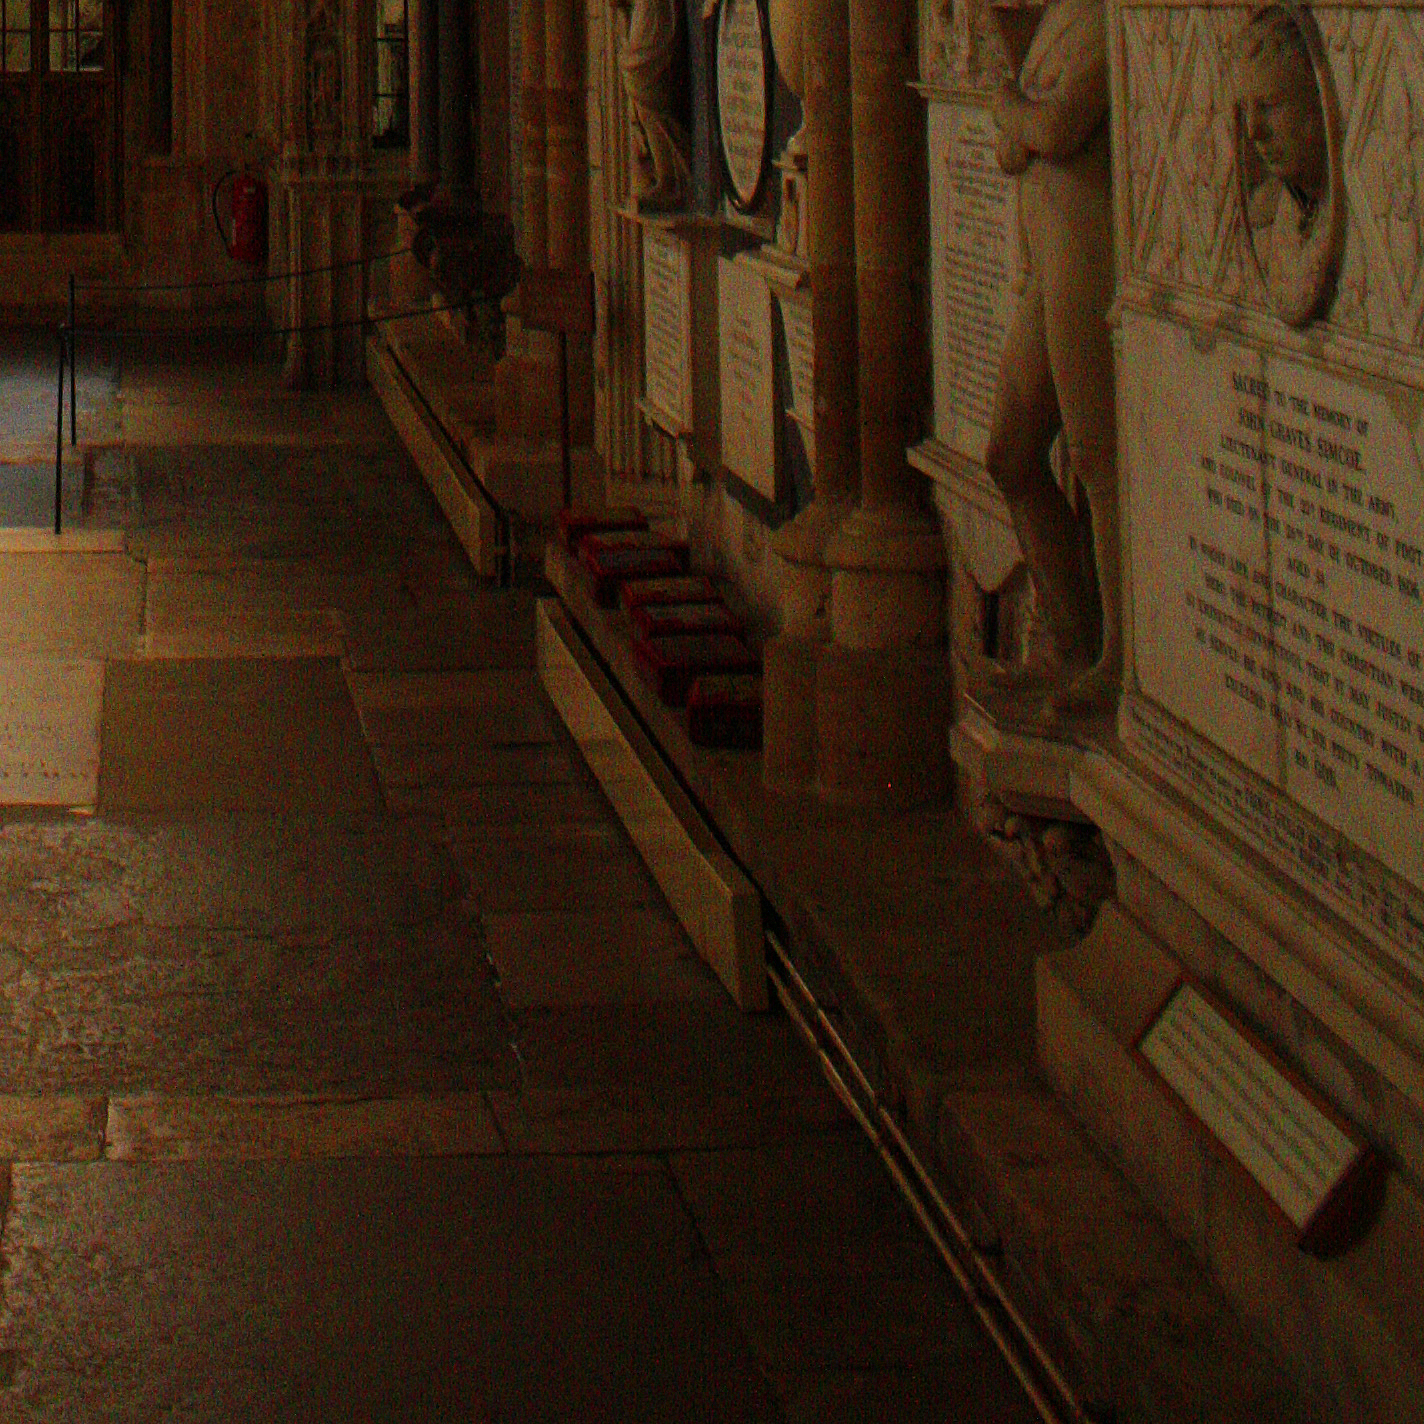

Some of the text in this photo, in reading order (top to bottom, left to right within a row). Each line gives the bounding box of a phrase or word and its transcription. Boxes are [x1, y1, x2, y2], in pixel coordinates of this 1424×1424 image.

[1270, 420, 1312, 453] GRAVES
[1289, 395, 1309, 415] THE
[1313, 403, 1351, 431] MEMORY
[1356, 418, 1368, 436] OF
[1200, 455, 1216, 475] AND
[1219, 463, 1256, 492] COLONEL
[1277, 488, 1294, 508] THE
[1319, 506, 1370, 543] REGIMENT
[1376, 532, 1389, 550] OF
[1280, 458, 1322, 489] GENERAL
[1327, 477, 1338, 494] IN
[1343, 483, 1362, 506] THE
[1287, 557, 1310, 579] AGED
[1307, 533, 1324, 554] DAY
[1329, 543, 1340, 564] OF
[1346, 552, 1392, 587] OCTOBER
[1275, 581, 1328, 620] CHARACTER
[1333, 609, 1352, 633] THE
[1357, 623, 1402, 660] VIRTUES
[1408, 650, 1420, 670] OF
[1316, 633, 1335, 657] THE
[1340, 647, 1394, 688] CHRISTIAN
[1310, 695, 1325, 718] HIS
[1330, 707, 1375, 748] COUNTRY
[1381, 737, 1408, 768] WITH
[1349, 686, 1370, 710] MAY
[1376, 701, 1411, 735] JUSTLY
[1331, 740, 1360, 772] PIETY
[1365, 761, 1415, 807] TOWARDS
